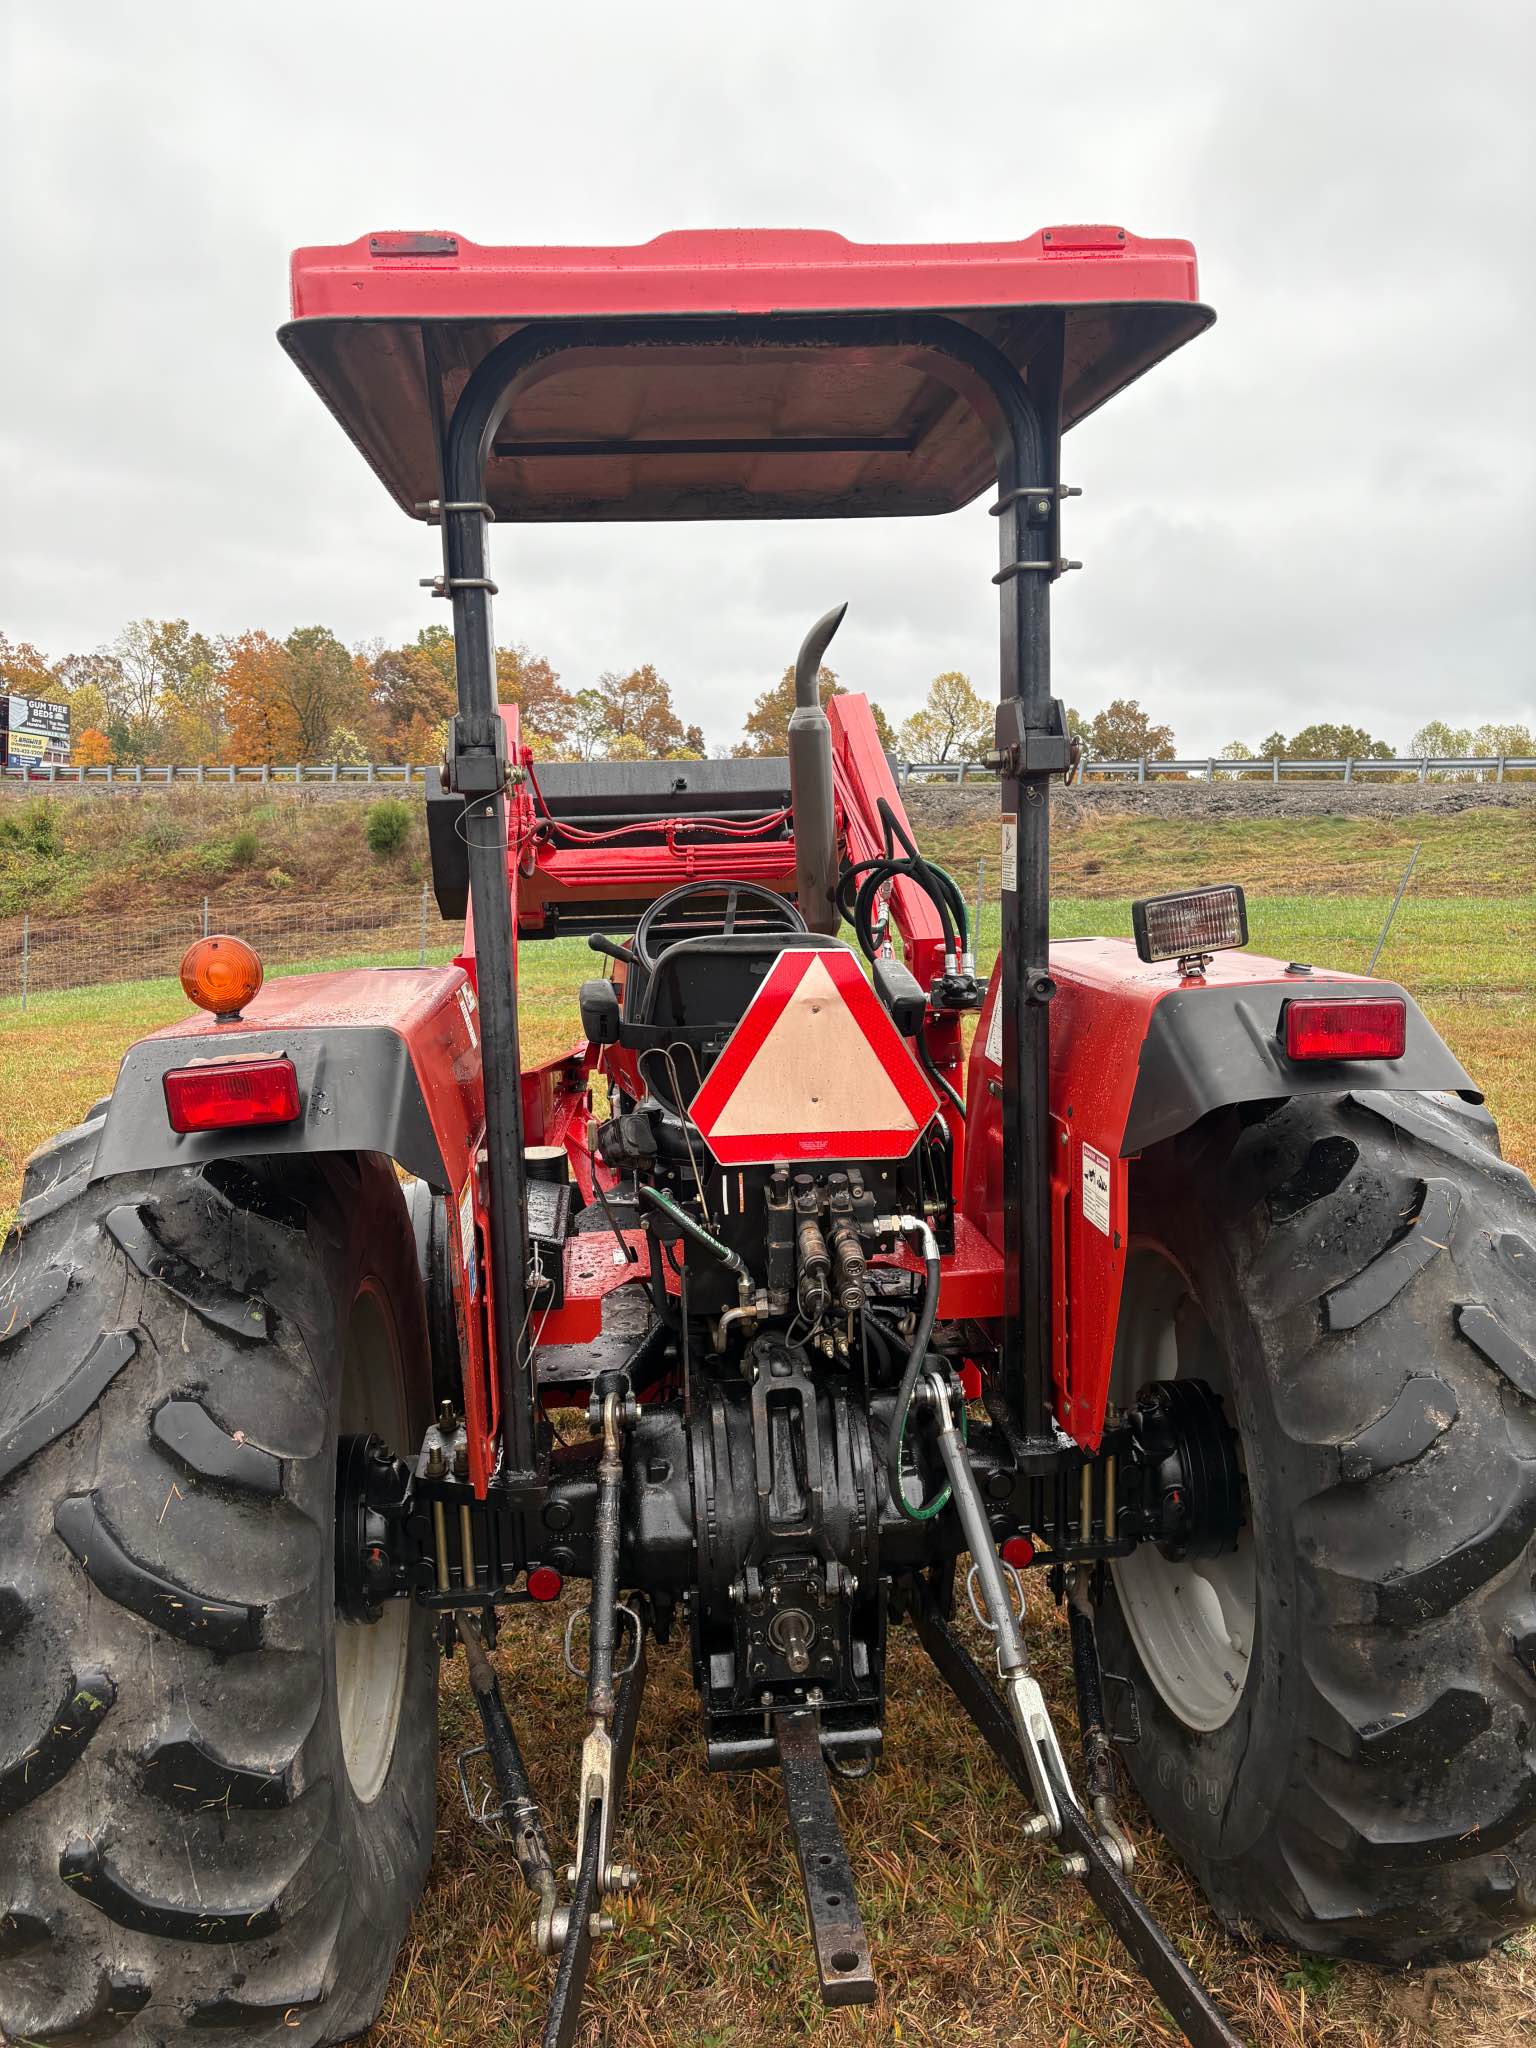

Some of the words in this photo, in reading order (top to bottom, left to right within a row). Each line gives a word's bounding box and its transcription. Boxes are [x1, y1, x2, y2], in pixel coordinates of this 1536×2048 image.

[29, 701, 46, 710] GUM
[48, 704, 68, 714] TREE
[33, 709, 54, 719] BEDS
